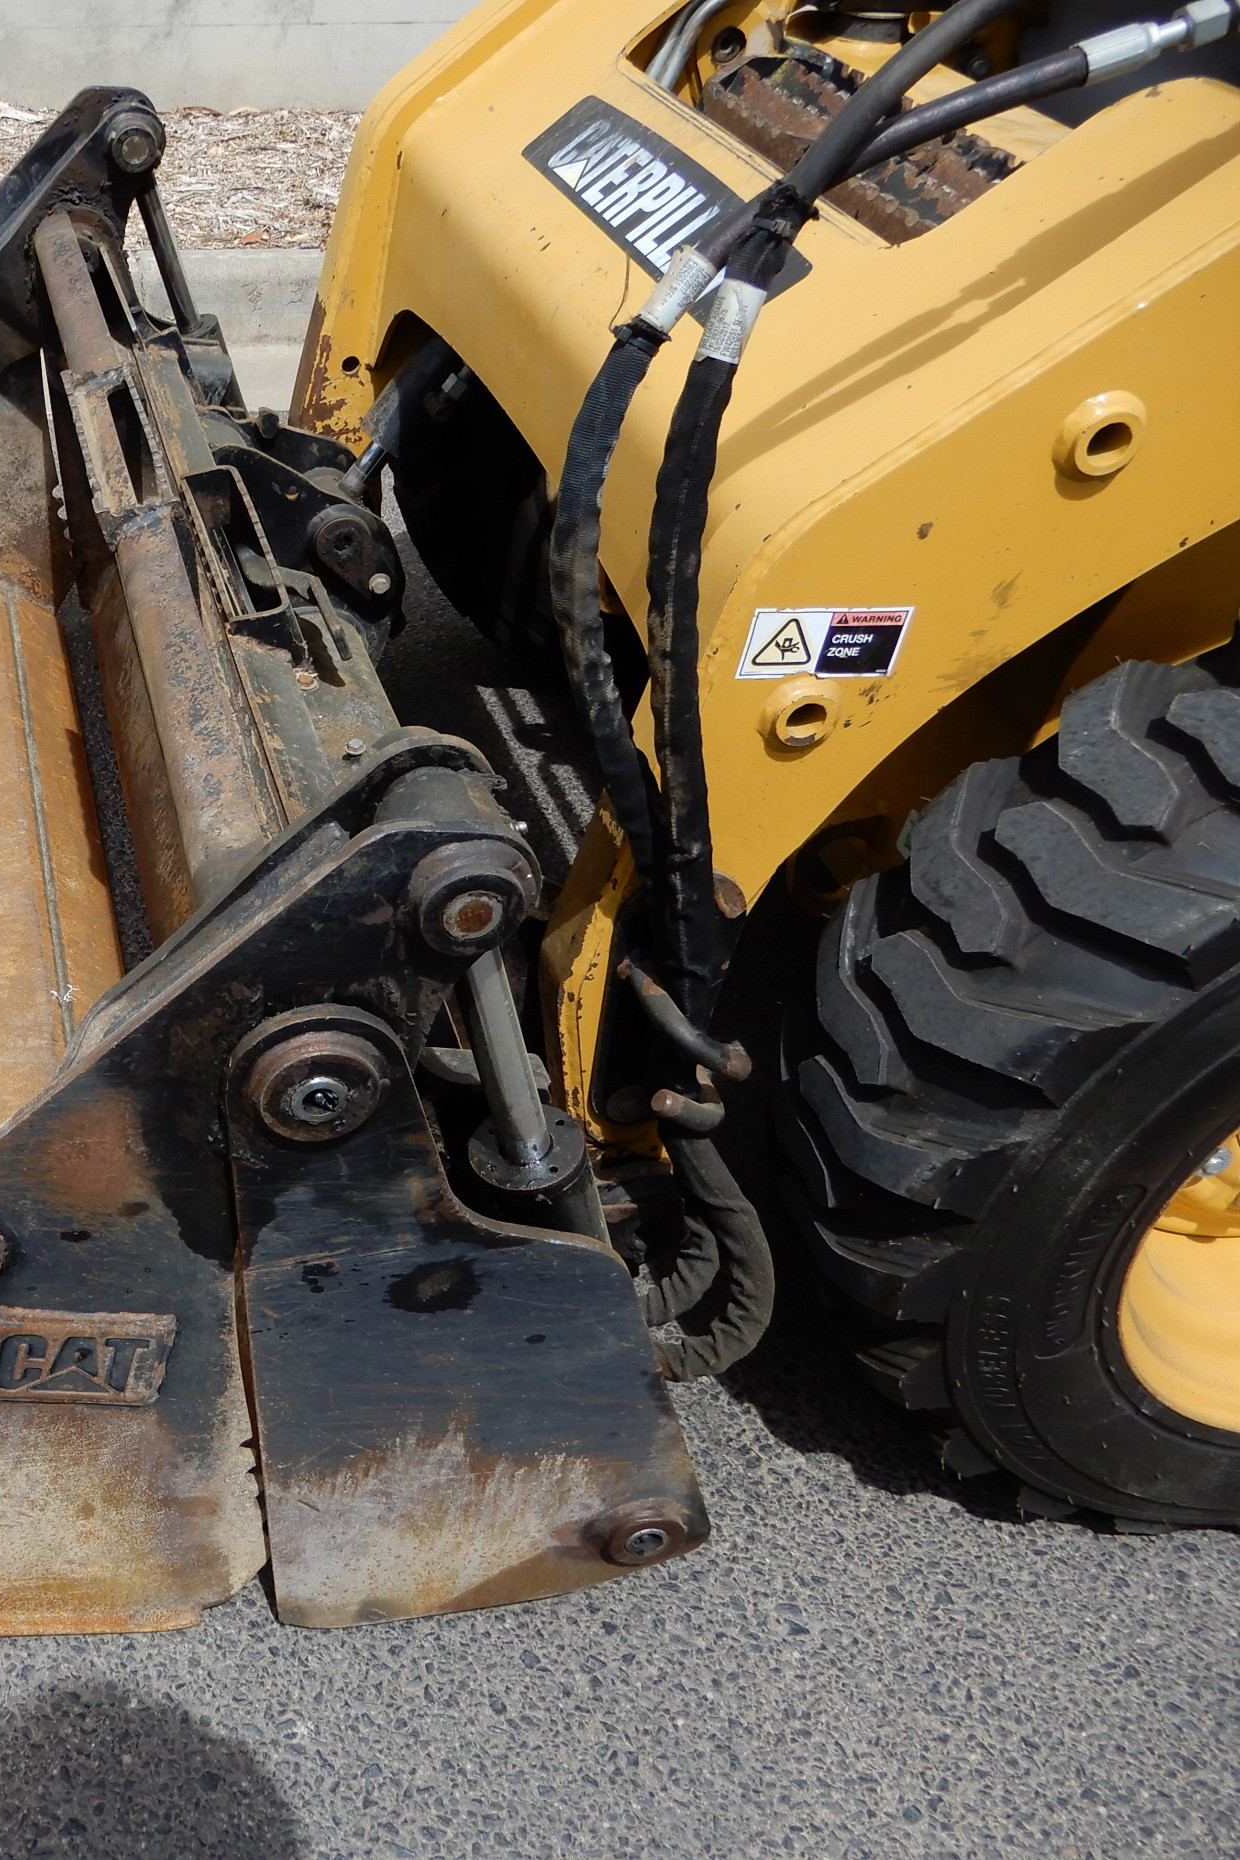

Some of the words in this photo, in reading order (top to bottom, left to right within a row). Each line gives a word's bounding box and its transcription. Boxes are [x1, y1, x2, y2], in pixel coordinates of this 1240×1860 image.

[548, 118, 724, 288] CATERPILL
[851, 614, 903, 624] WARNING
[831, 633, 873, 644] CRUSH
[826, 646, 861, 658] ZONE
